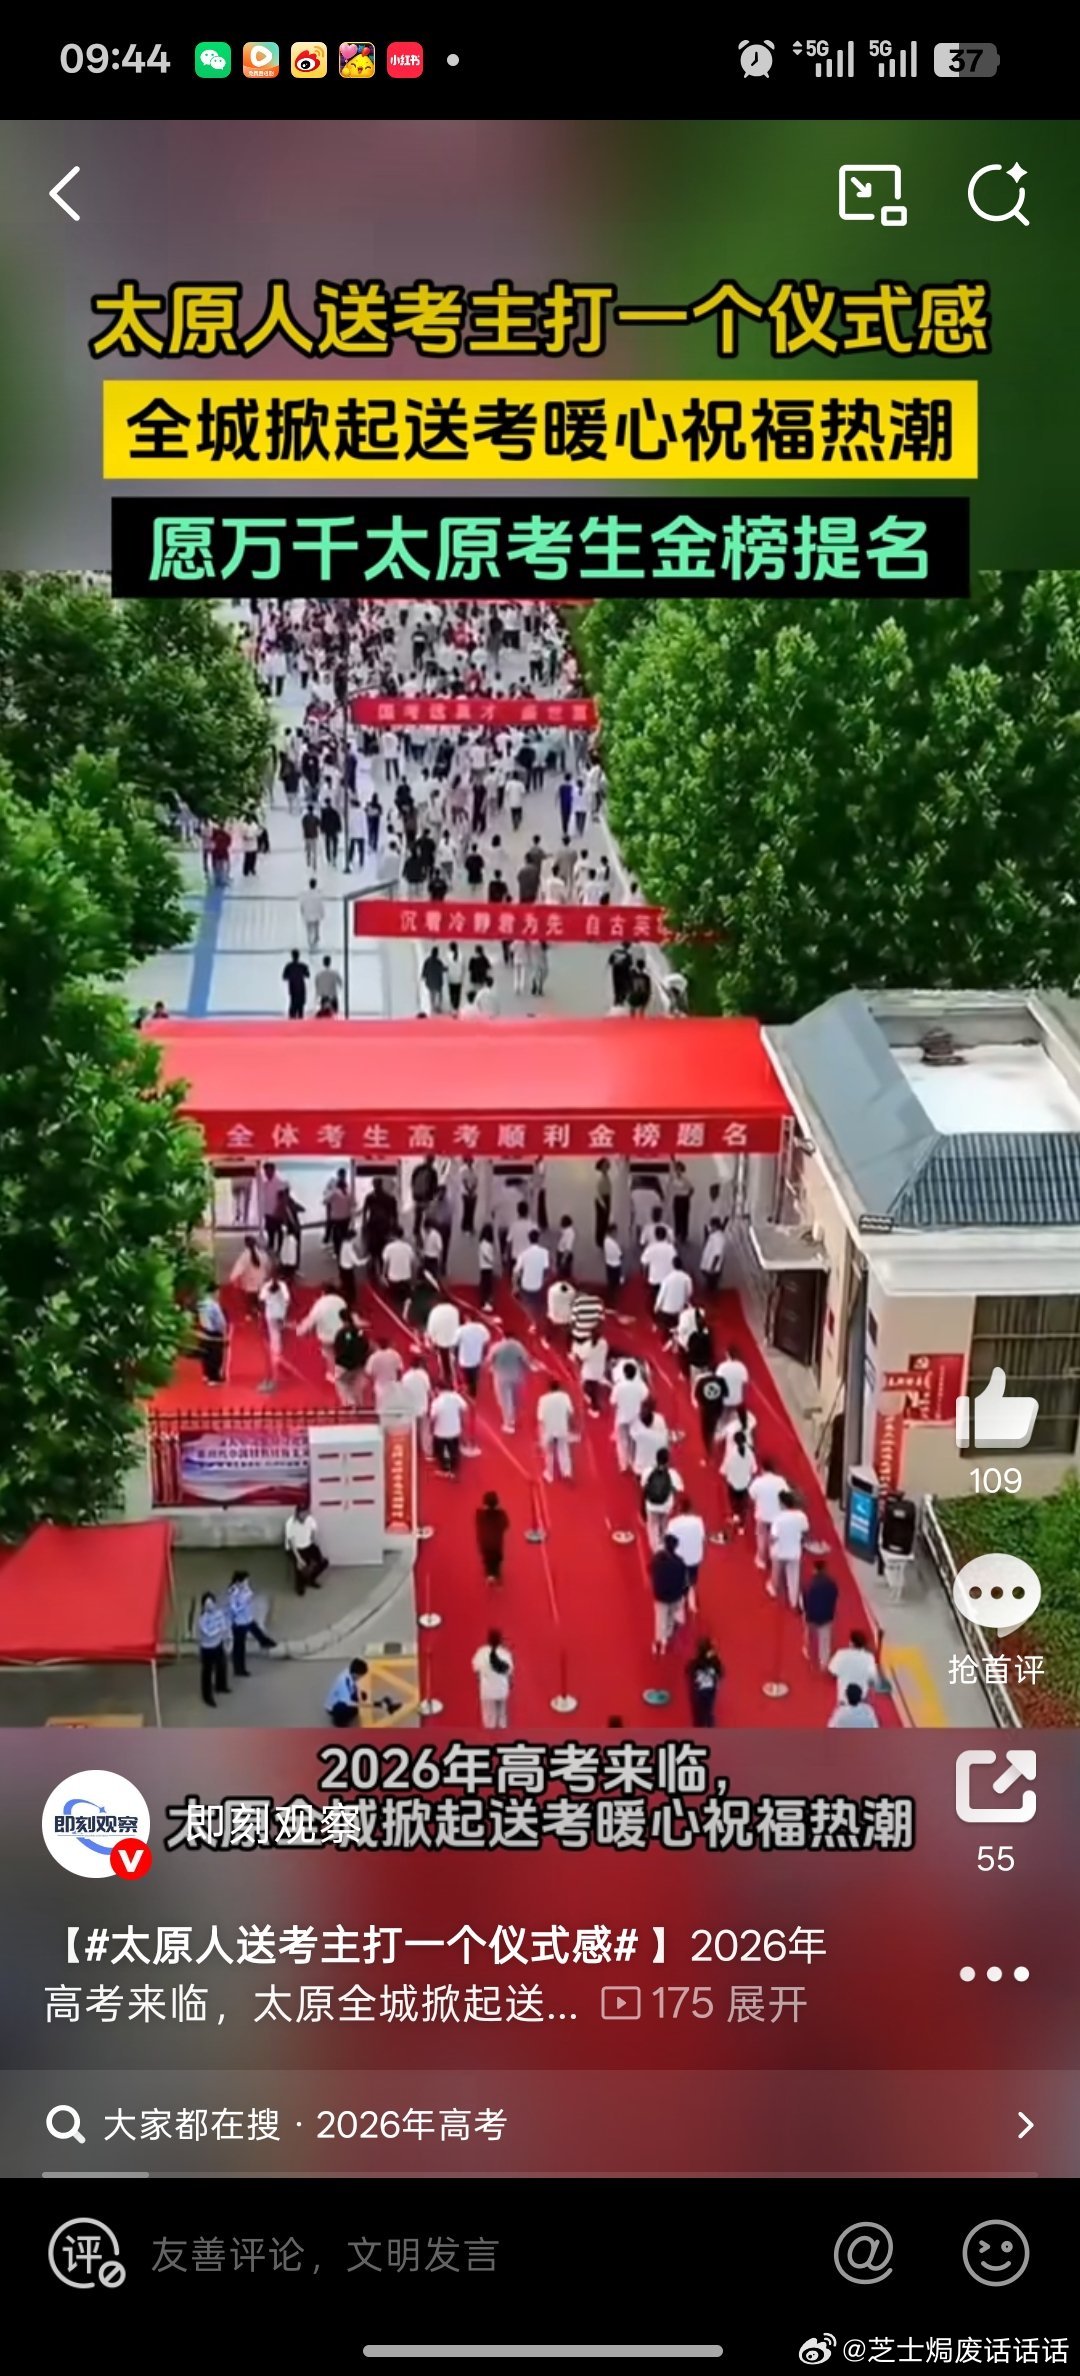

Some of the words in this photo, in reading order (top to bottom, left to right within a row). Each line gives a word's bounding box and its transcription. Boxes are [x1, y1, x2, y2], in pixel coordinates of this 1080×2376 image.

[61, 43, 171, 74] 09:44
[389, 53, 421, 66] 小红书
[806, 39, 830, 57] 5G
[869, 39, 893, 57] 5G
[948, 49, 984, 73] 37
[971, 1467, 1022, 1493] 109
[948, 1653, 1045, 1685] 抢首评
[54, 1815, 138, 1834] 即刻观察
[186, 1802, 361, 1845] 即刻观察
[977, 1846, 1015, 1872] 55
[652, 1986, 714, 2019] 175
[727, 1985, 808, 2023] 展开
[103, 2106, 282, 2143] 大家都在搜
[316, 2106, 508, 2143] 2026年高考
[62, 2235, 103, 2274] 评
[151, 2235, 500, 2275] 友善评论，文明发言
